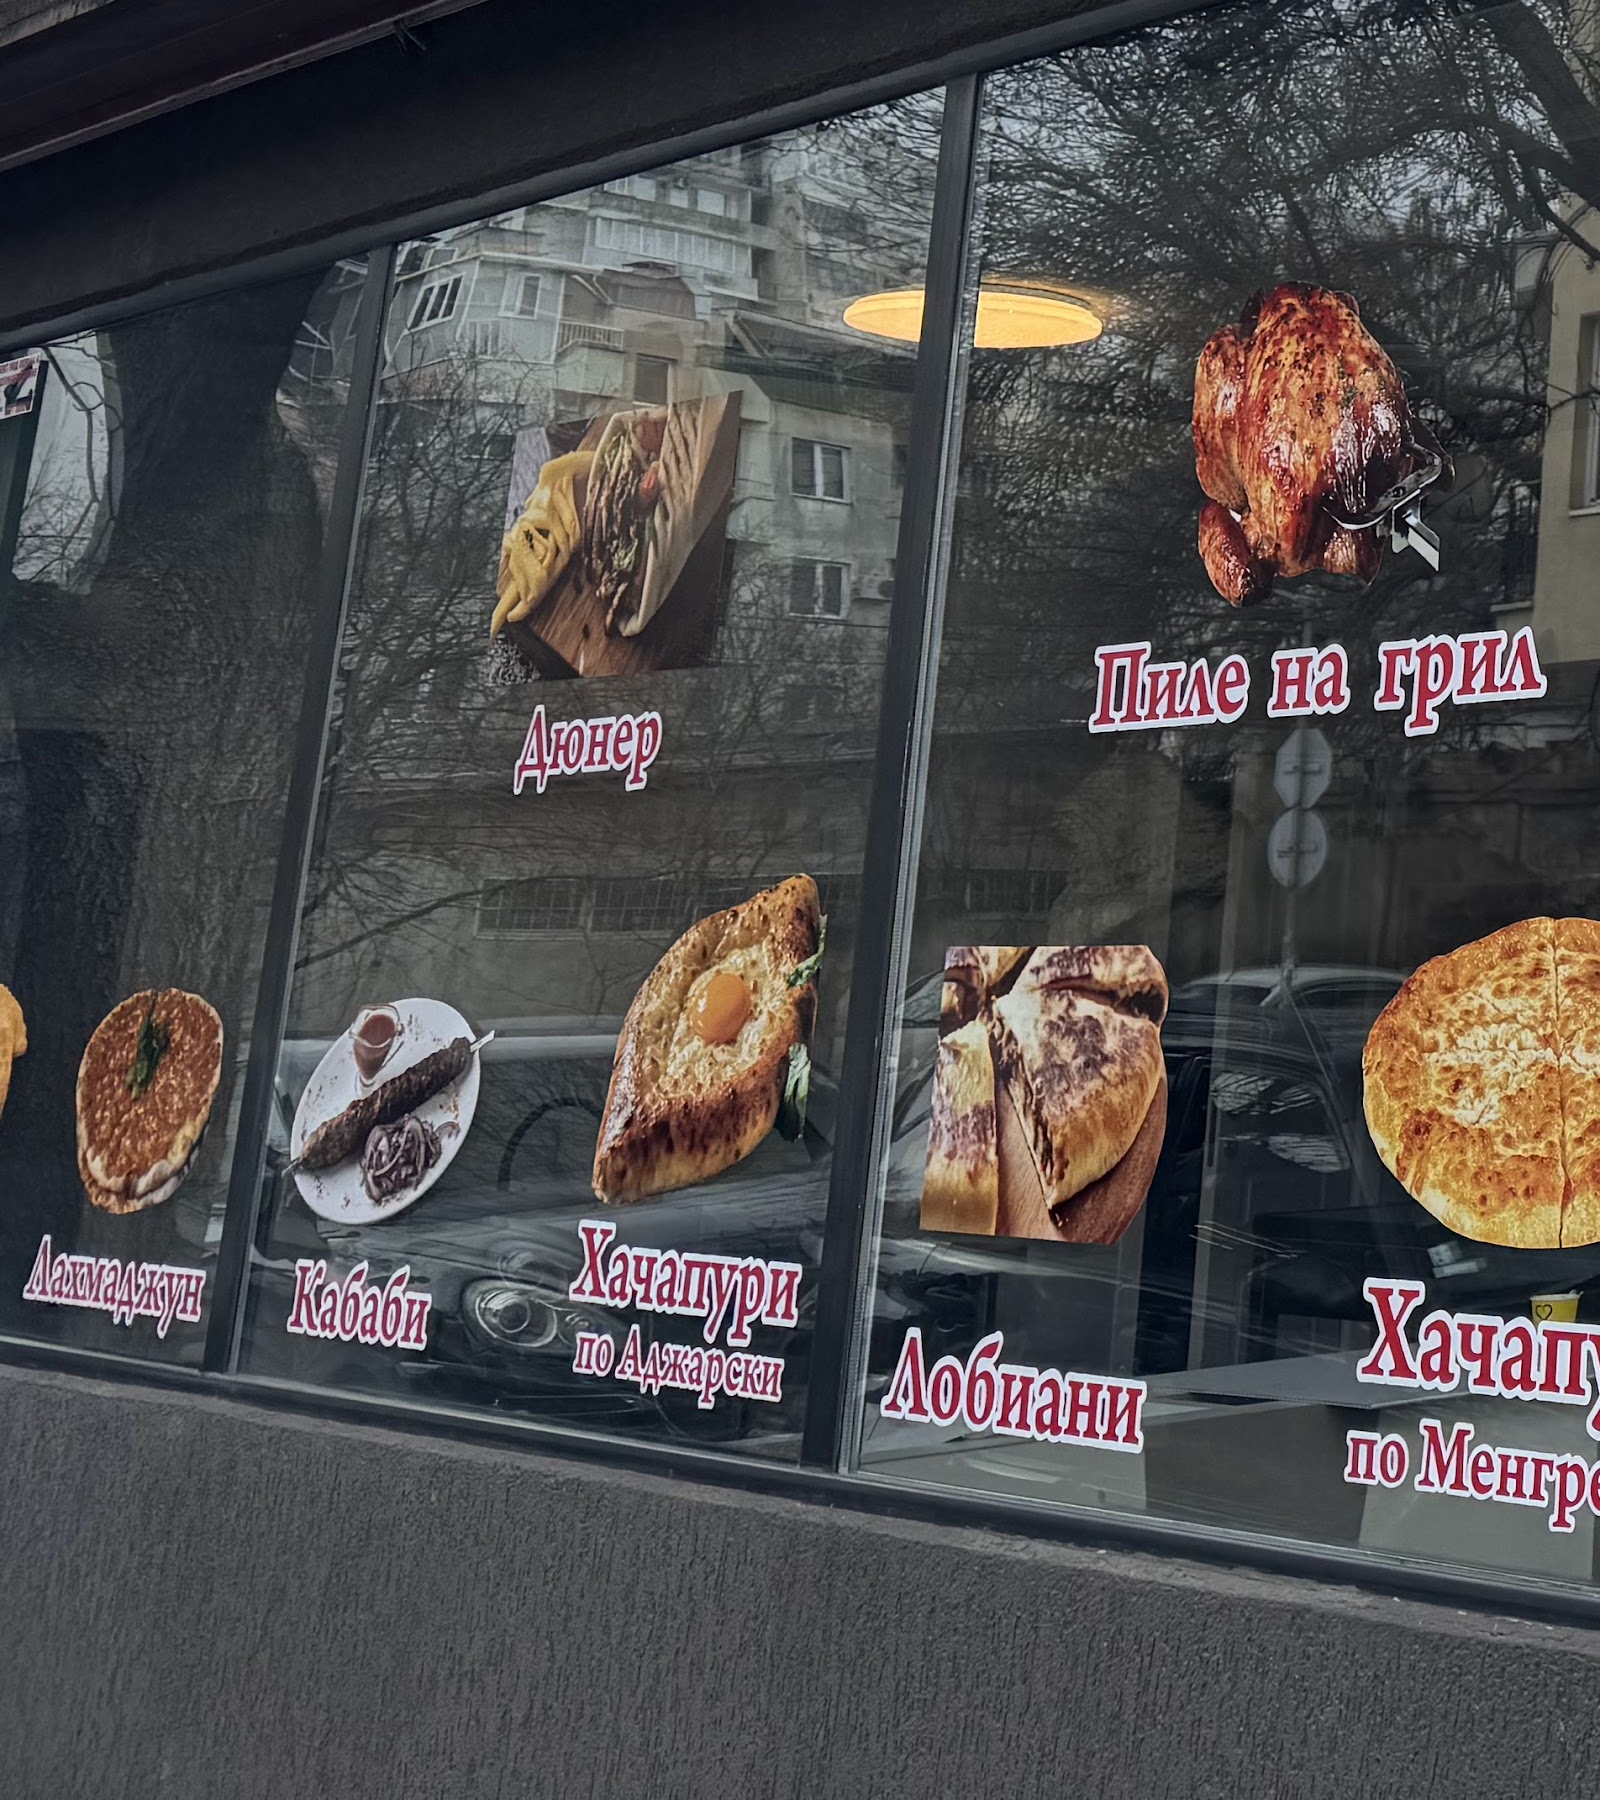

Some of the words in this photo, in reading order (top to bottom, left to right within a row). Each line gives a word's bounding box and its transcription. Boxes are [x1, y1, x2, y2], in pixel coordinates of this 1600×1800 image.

[1091, 645, 1248, 733] Пиле
[1269, 647, 1349, 716] на
[1376, 631, 1546, 735] грил
[515, 708, 661, 792] Дюнер
[27, 1238, 203, 1336] Лахмаджун
[290, 1262, 430, 1347] Кабаби
[573, 1223, 800, 1346] Хачапури
[576, 1333, 611, 1374] по
[616, 1326, 783, 1407] Аджарски
[884, 1332, 1145, 1450] Лобиани
[1347, 1431, 1408, 1485] по
